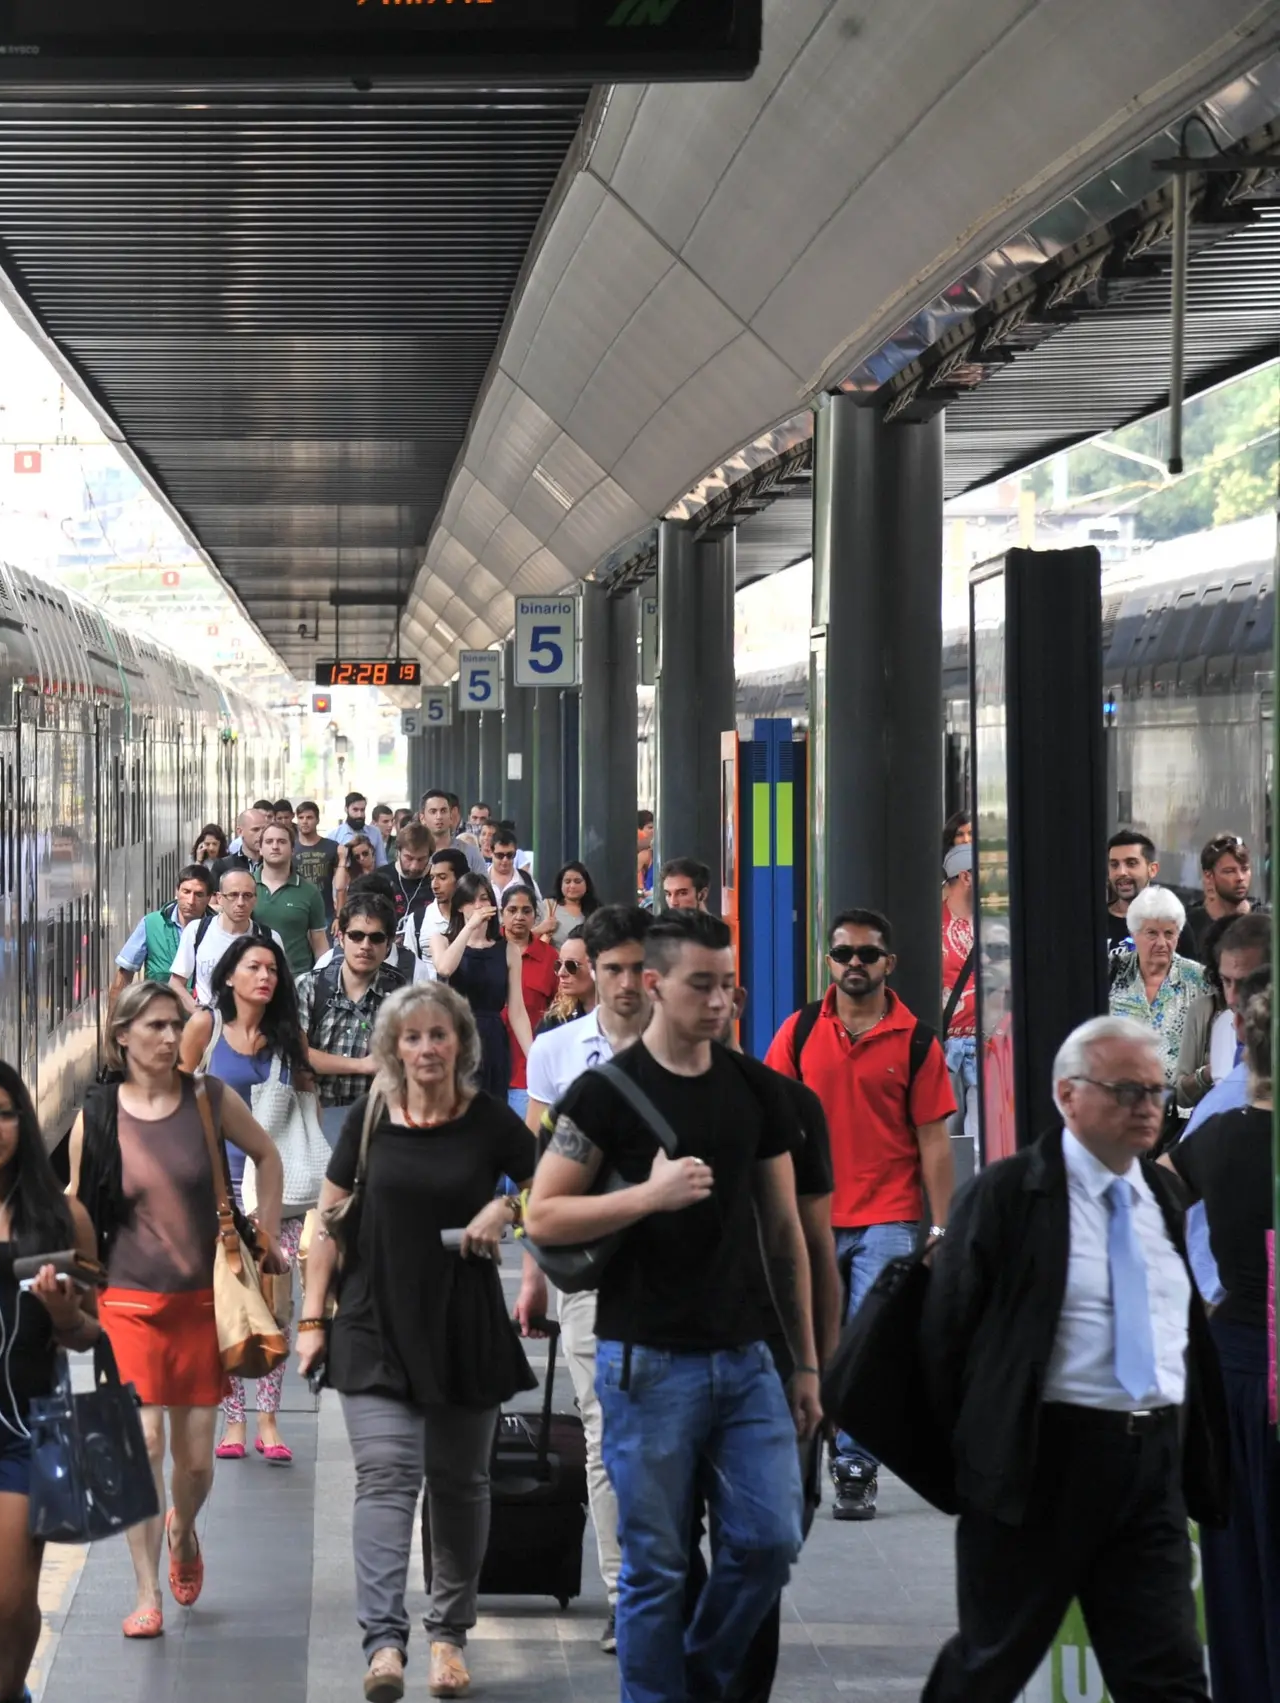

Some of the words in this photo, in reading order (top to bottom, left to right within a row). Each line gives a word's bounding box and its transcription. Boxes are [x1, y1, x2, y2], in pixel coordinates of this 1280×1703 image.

[520, 603, 571, 615] binario
[463, 654, 497, 662] binario
[528, 626, 563, 674] 5
[330, 664, 388, 685] 12:28
[399, 665, 415, 680] 19
[468, 670, 491, 702] 5
[428, 699, 444, 721] 5
[405, 717, 416, 733] 5
